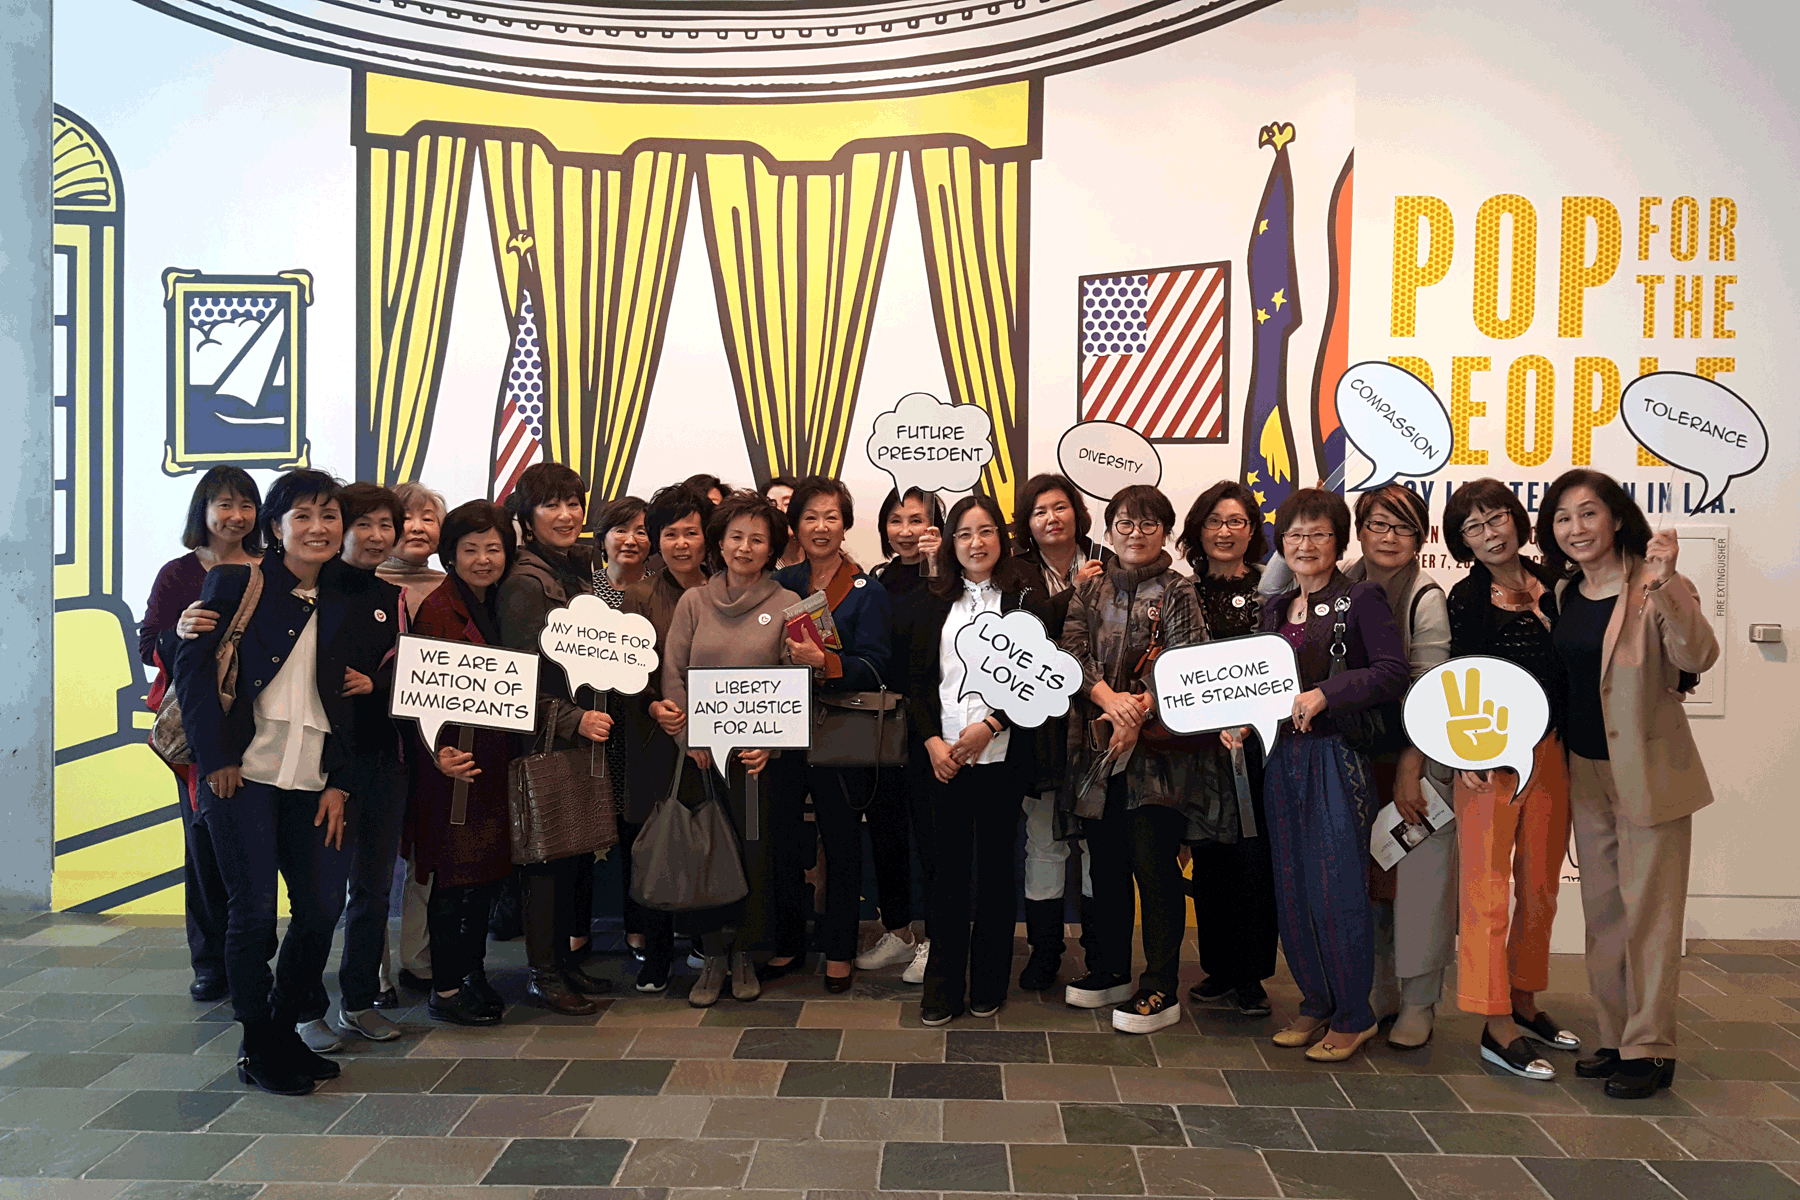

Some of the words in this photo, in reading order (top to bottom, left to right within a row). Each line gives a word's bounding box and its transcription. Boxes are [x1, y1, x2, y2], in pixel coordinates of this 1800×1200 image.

[1637, 195, 1738, 262] FOR
[1390, 193, 1622, 340] POP
[1636, 274, 1738, 339] THE
[1350, 379, 1440, 460] COMPASSION
[1387, 354, 1736, 467] EOP
[1644, 398, 1748, 449] TOLERANCE
[896, 425, 965, 441] FUTURE
[877, 445, 984, 463] PRESIDENT
[1078, 447, 1144, 474] DIVERSITY
[1647, 482, 1672, 514] IN
[1717, 538, 1727, 598] EXTINGUISHER
[1716, 599, 1725, 617] FIRE
[550, 622, 573, 635] MY
[577, 626, 617, 644] HOPE
[621, 634, 650, 650] FOR
[420, 648, 451, 666] WE
[457, 653, 499, 672] ARE
[504, 660, 519, 676] A
[554, 640, 619, 663] AMERICA
[623, 652, 646, 668] IS...
[978, 622, 1035, 670] LOVE
[1033, 664, 1065, 691] IS
[411, 670, 487, 693] NATION
[494, 680, 524, 697] OF
[715, 680, 782, 695] LIBERTY
[980, 655, 1036, 703] LOVE
[1180, 660, 1270, 687] WELCOME
[400, 690, 530, 720] IMMIGRANTS
[694, 700, 729, 715] AND
[733, 700, 803, 715] JUSTICE
[1163, 692, 1196, 710] THE
[1201, 678, 1295, 705] STRANGER
[713, 720, 748, 735] FOR
[752, 720, 783, 735] ALL
